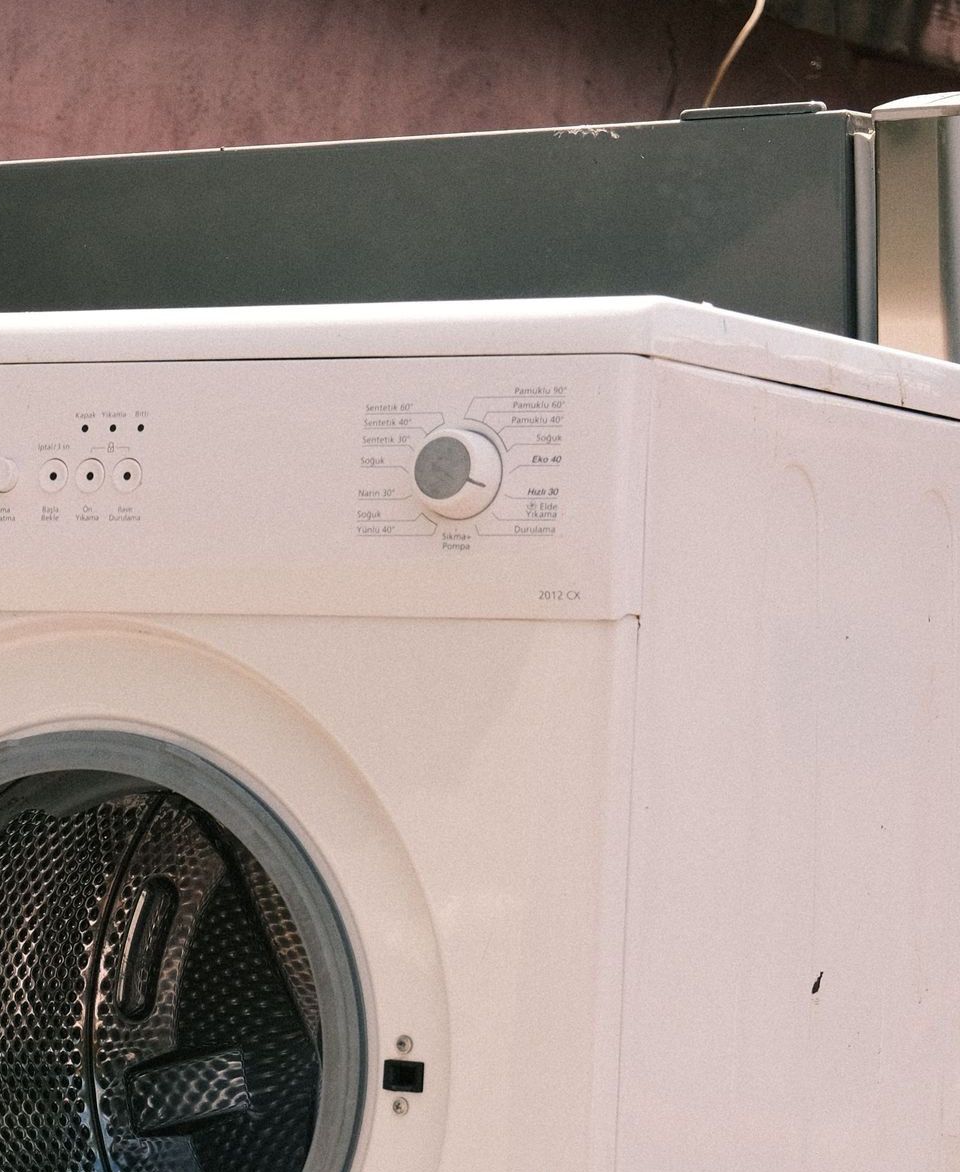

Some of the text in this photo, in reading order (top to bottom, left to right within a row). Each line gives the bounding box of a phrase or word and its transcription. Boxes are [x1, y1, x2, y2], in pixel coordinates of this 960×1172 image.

[515, 387, 550, 395] Pamuklu
[513, 401, 549, 409] Pamuklu
[512, 416, 548, 424] Pamuklu
[536, 434, 561, 442] Soğuk
[539, 591, 580, 600] 2012 CX
